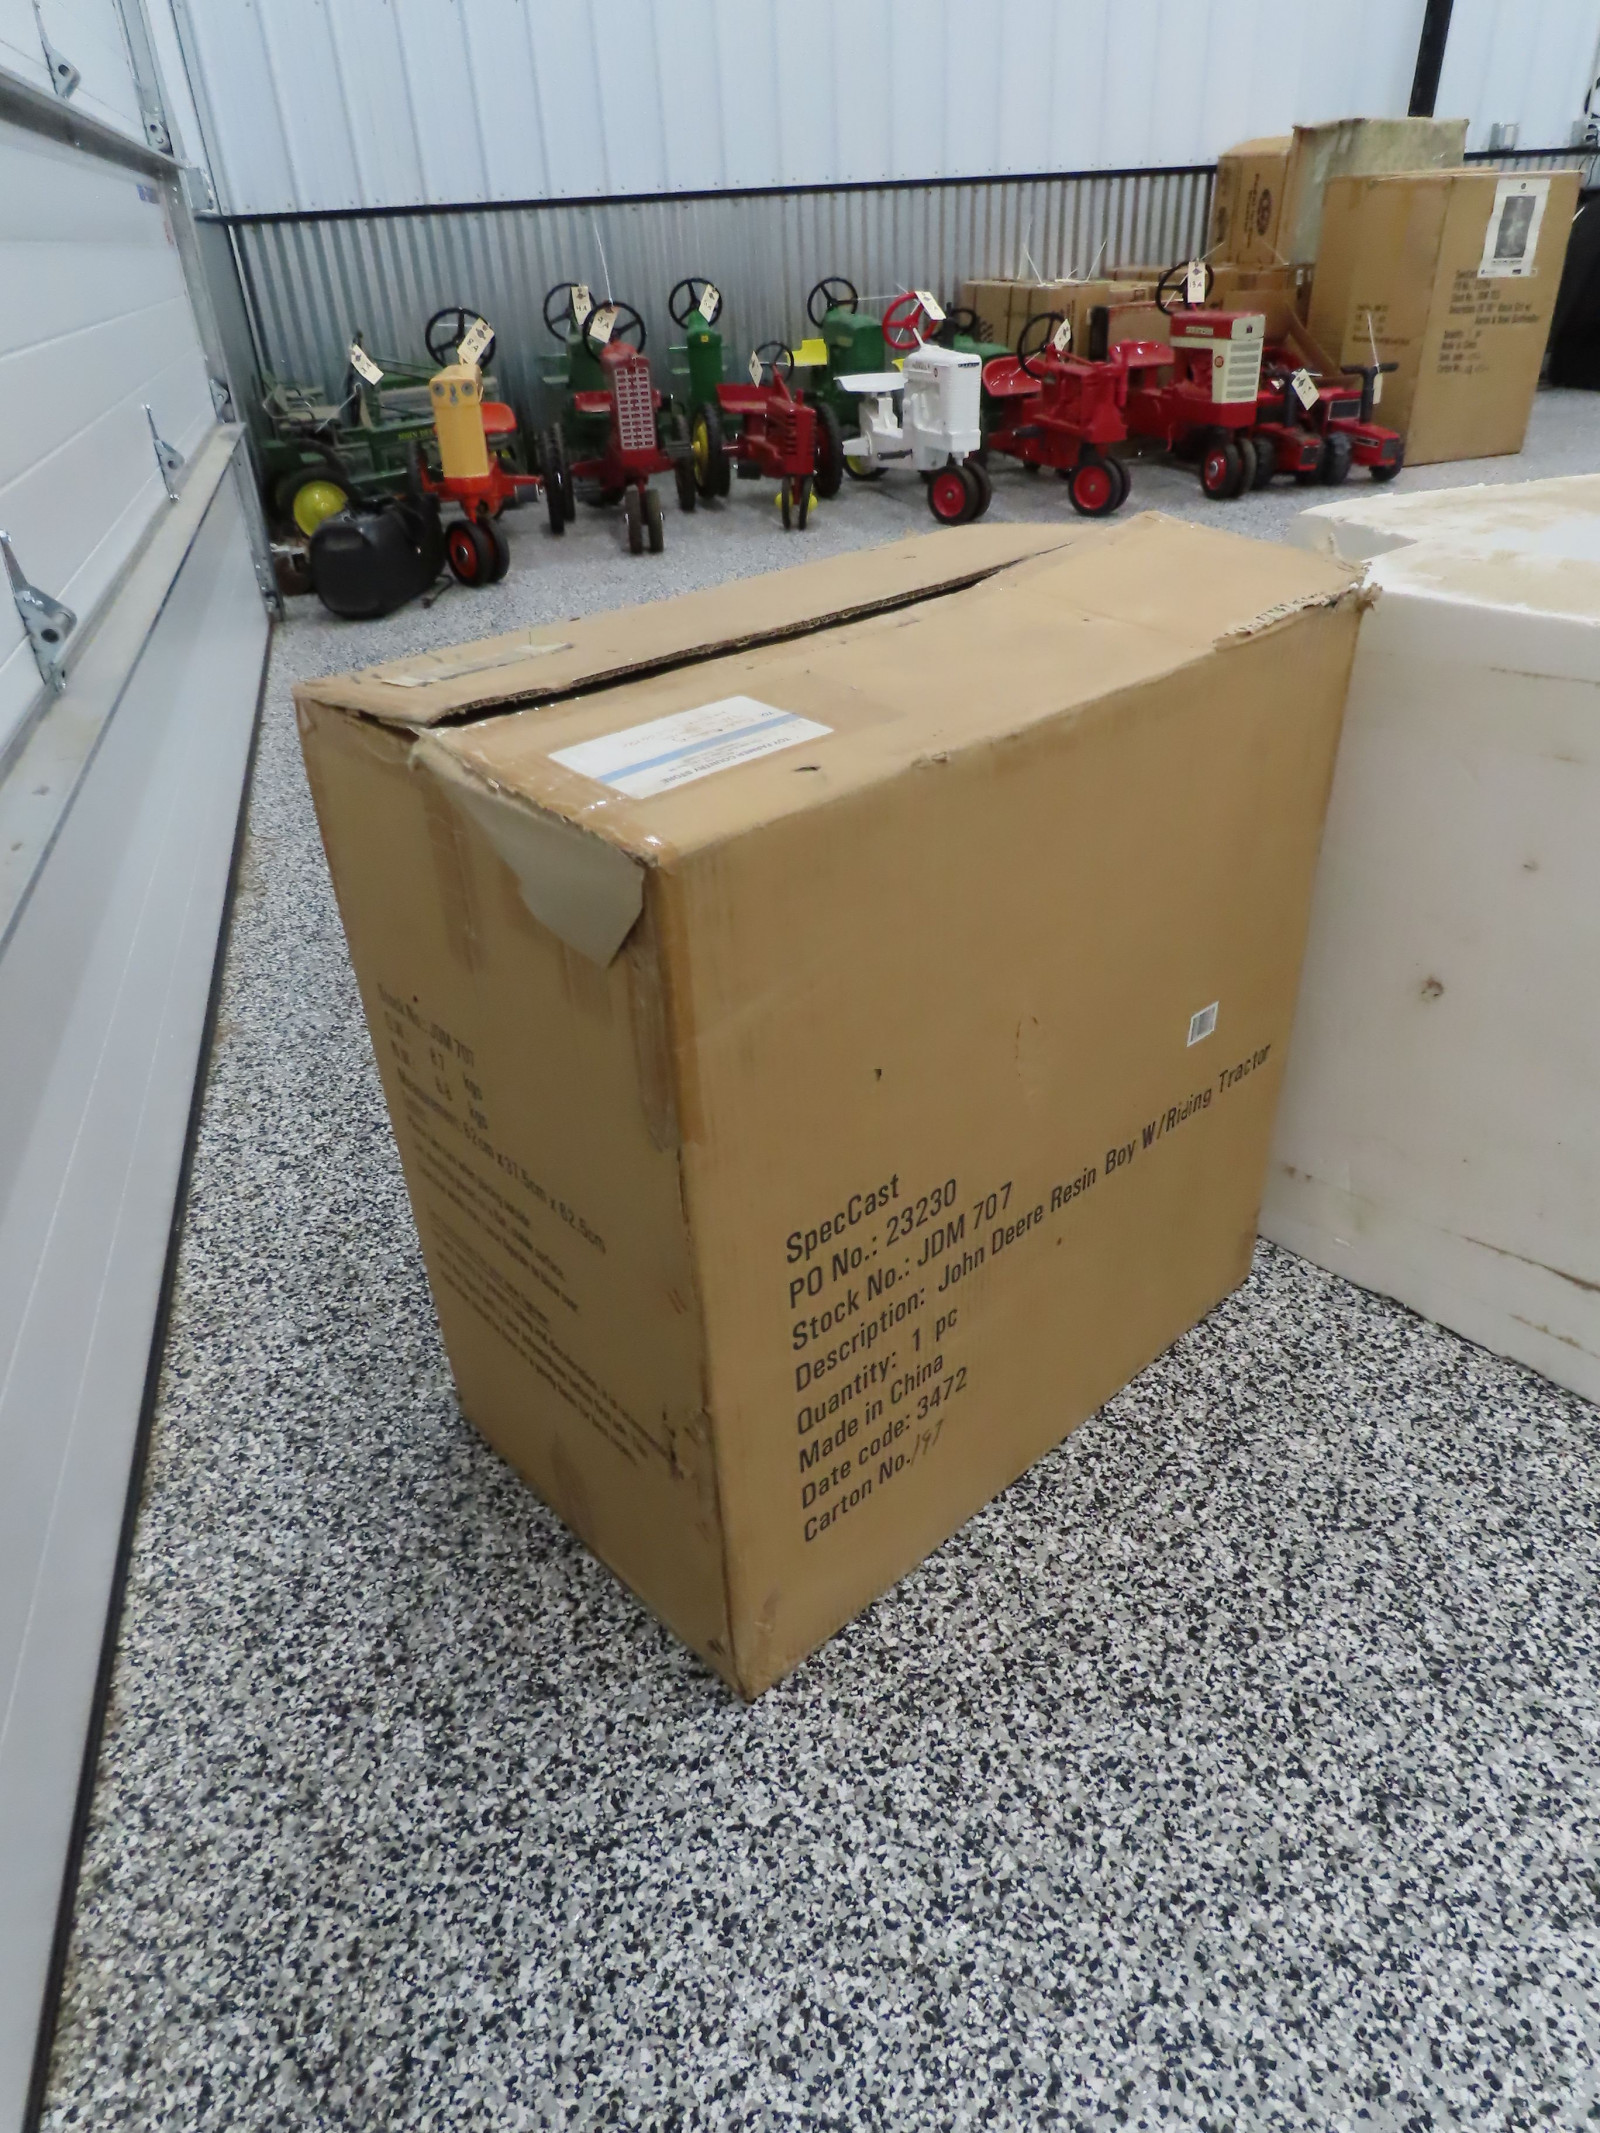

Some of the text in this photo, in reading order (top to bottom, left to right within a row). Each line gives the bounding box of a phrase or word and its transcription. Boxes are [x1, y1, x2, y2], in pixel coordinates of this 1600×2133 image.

[786, 1173, 899, 1263] SpecCast
[789, 1178, 957, 1309] PO No.: 23230
[792, 1181, 1013, 1351] Stock No.: JDM 707
[795, 1044, 1272, 1392] Description: John Deere Resin Boy W/Riding Tractor
[797, 1308, 958, 1436] Quantity: 1 pc
[799, 1354, 943, 1474] Made in China
[802, 1366, 967, 1510] Date code: 3472
[804, 1454, 911, 1543] Carton No.
